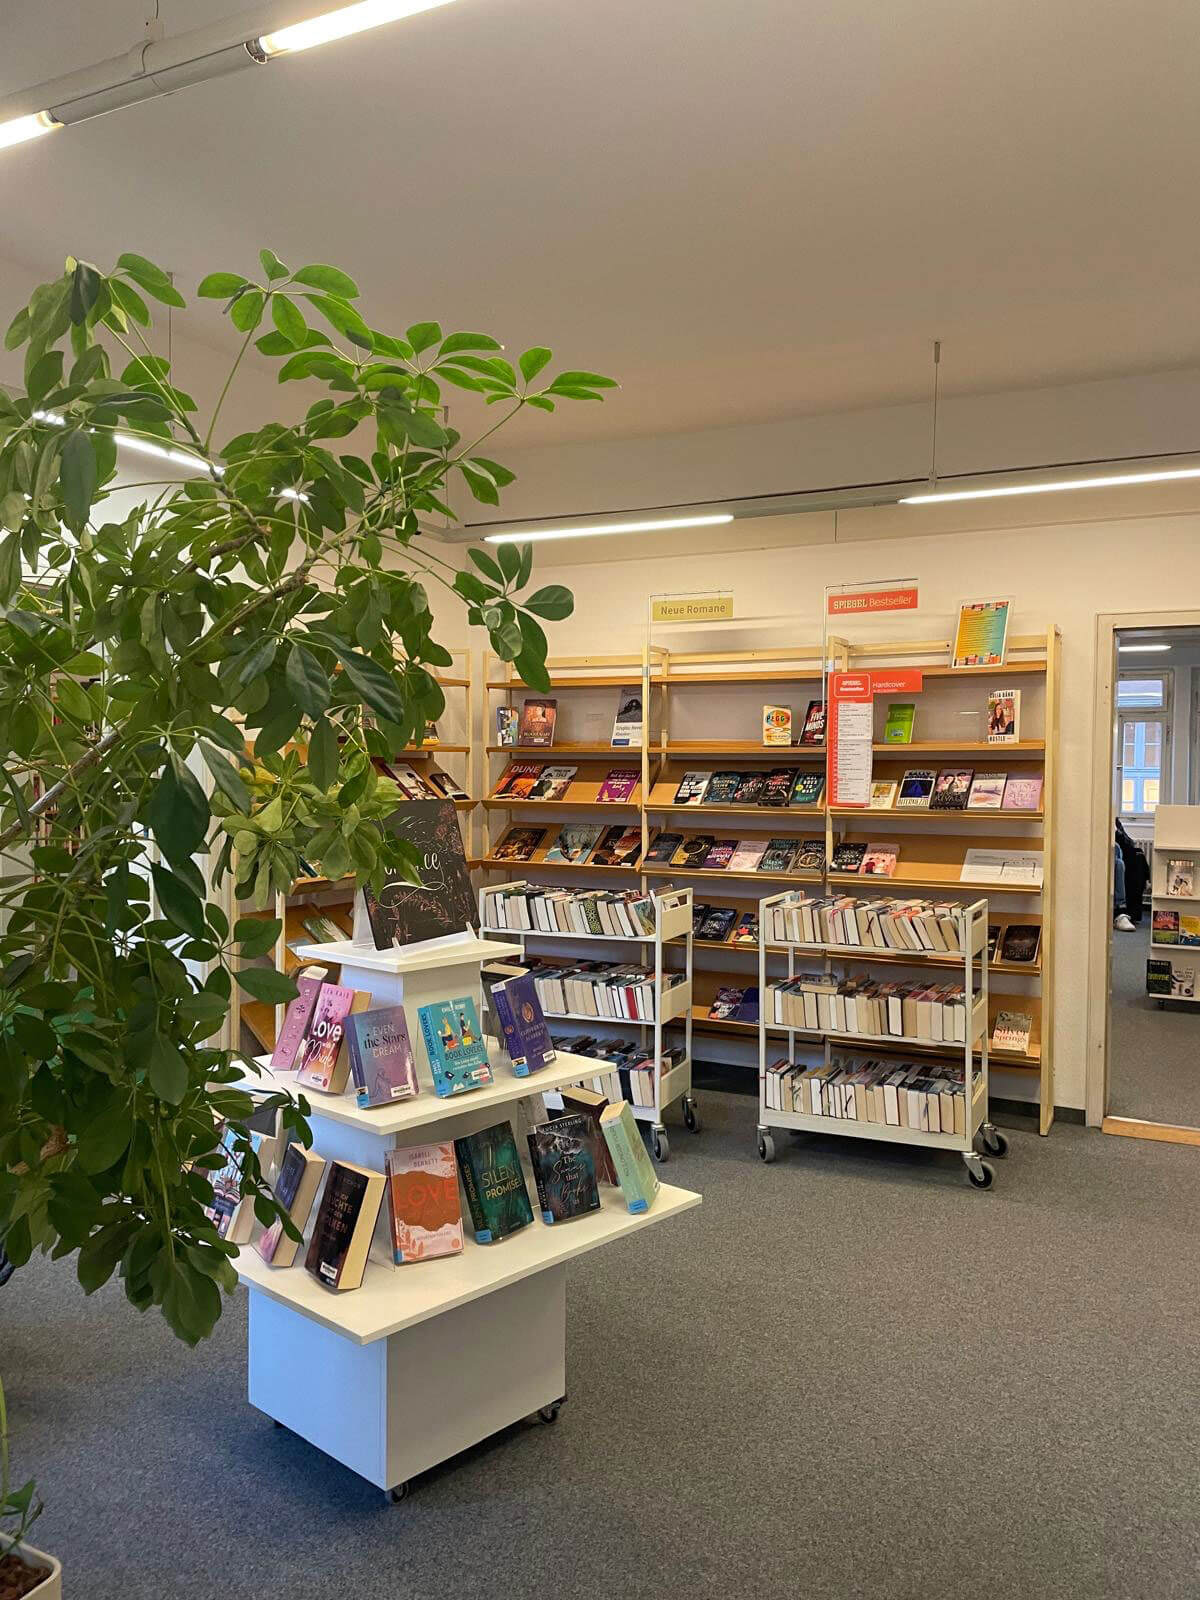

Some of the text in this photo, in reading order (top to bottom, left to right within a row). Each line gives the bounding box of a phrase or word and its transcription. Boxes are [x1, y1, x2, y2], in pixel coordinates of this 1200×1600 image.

[834, 595, 912, 609] SPIEGEL Bestseller
[661, 604, 726, 615] Neue Romane
[510, 765, 539, 773] DUNE
[312, 1021, 342, 1041] Love
[396, 1179, 457, 1209] LOVE
